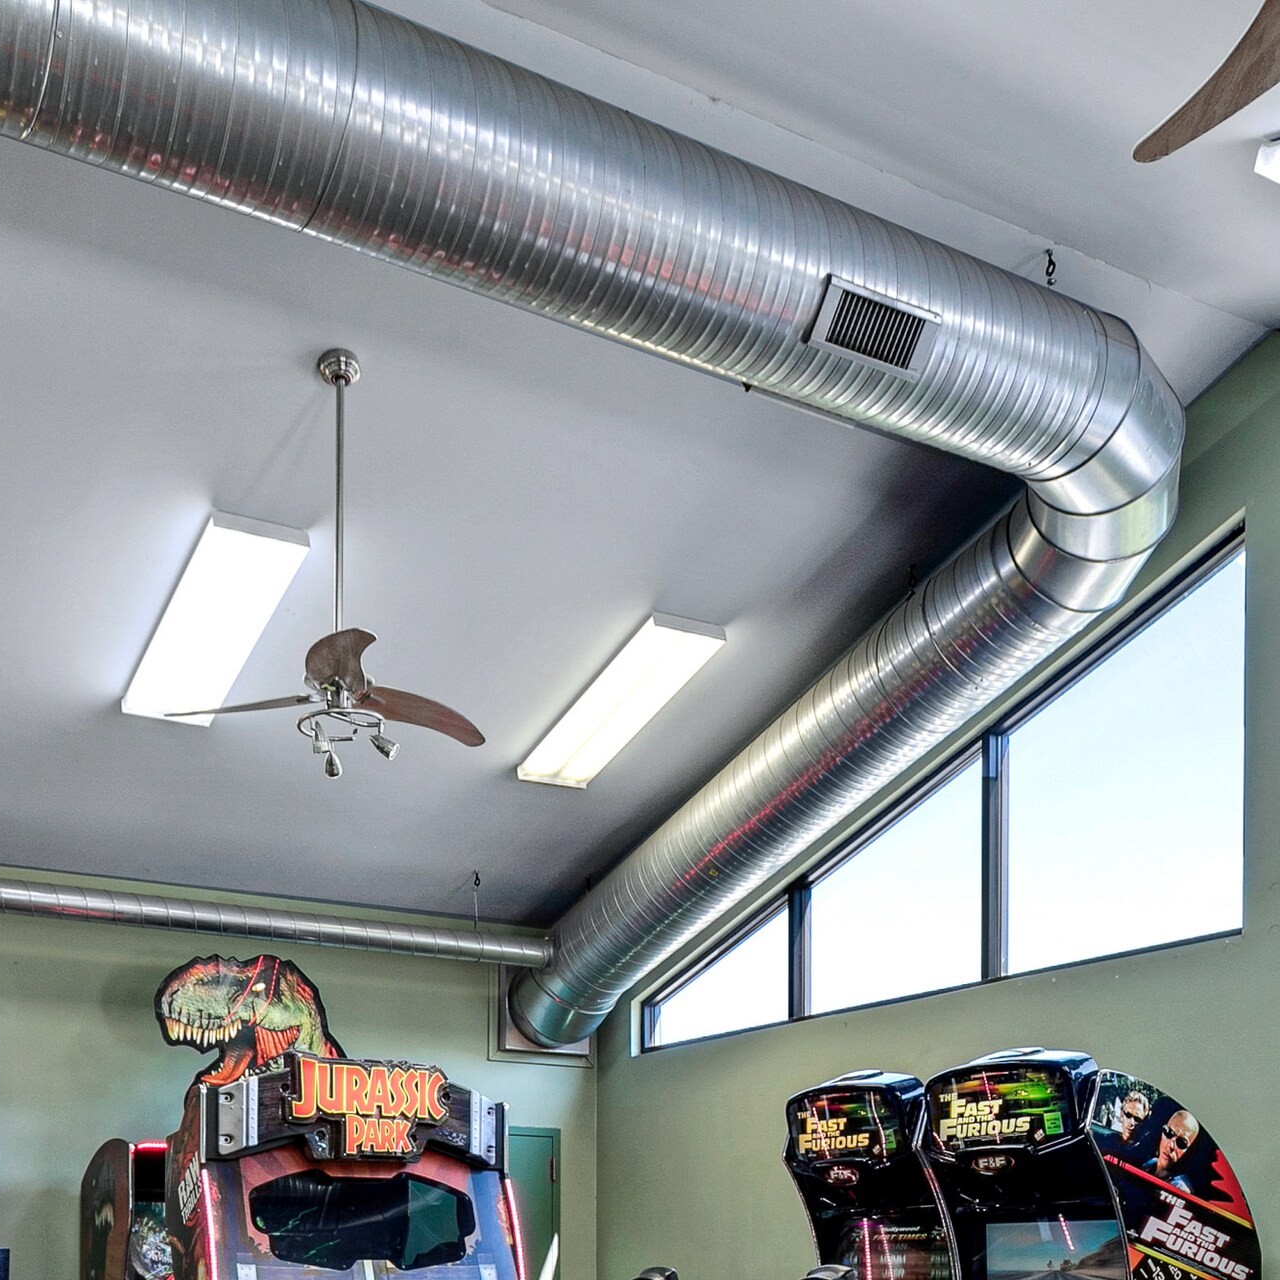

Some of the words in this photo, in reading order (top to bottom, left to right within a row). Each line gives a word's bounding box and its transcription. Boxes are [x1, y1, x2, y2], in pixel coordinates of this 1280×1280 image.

[292, 1057, 447, 1121] JURASSIC
[939, 1093, 958, 1103] THE
[796, 1111, 812, 1120] THE
[949, 1098, 1004, 1120] FAST
[805, 1117, 848, 1135] FAST
[939, 1116, 1032, 1142] FURIOUS
[956, 1115, 977, 1124] AND
[345, 1113, 412, 1155] PARK
[798, 1132, 871, 1154] FURIOUS
[977, 1155, 1007, 1170] F&F
[1160, 1190, 1186, 1209] THE
[1166, 1206, 1231, 1248] FAST
